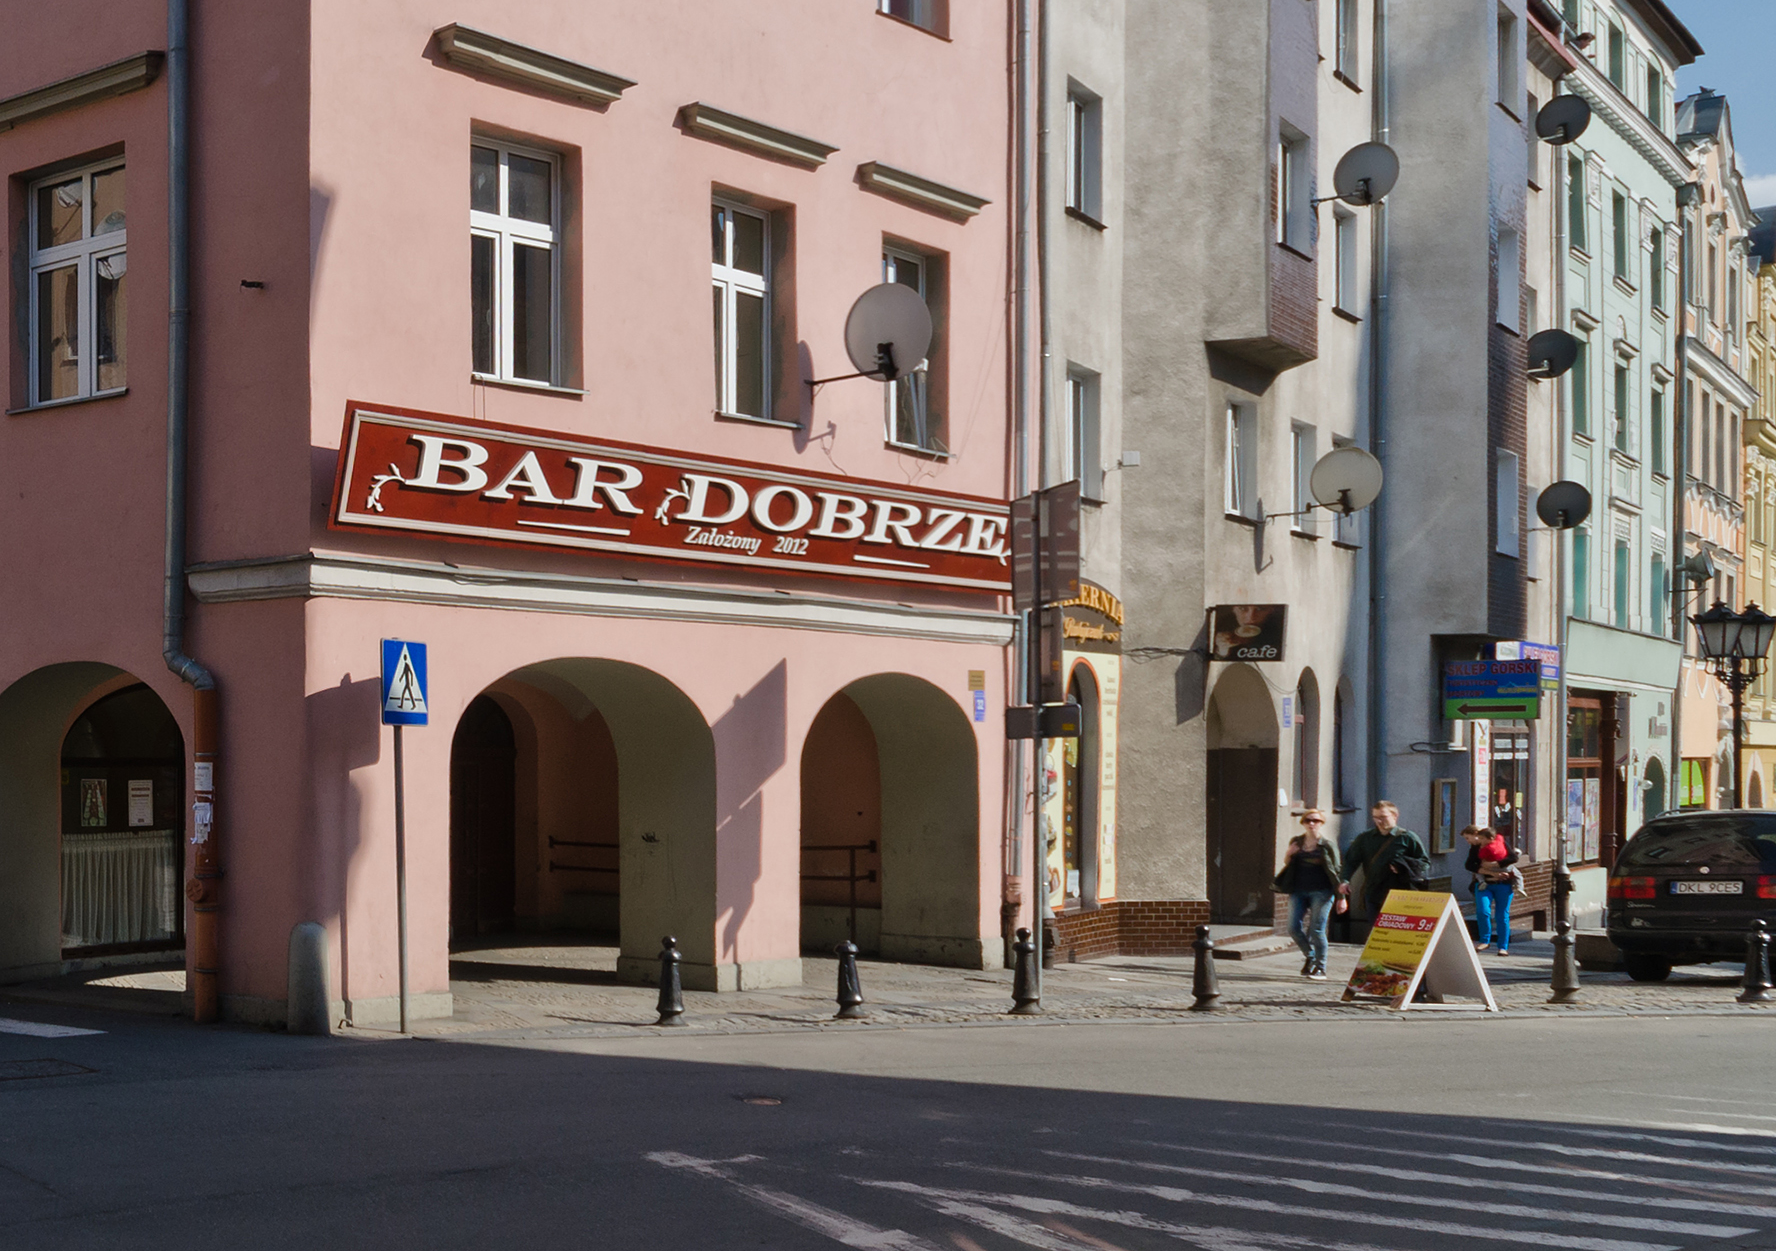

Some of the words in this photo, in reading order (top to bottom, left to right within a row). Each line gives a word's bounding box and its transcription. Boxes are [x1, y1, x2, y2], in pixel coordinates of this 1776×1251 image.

[404, 433, 645, 516] BAR
[675, 472, 1010, 557] DOBRZE
[683, 525, 762, 556] Założony
[772, 535, 810, 556] 2012
[1236, 644, 1278, 659] cafe
[1448, 663, 1487, 677] SKLEP
[1678, 883, 1705, 892] DKL
[1708, 883, 1741, 893] 9CES
[1378, 921, 1415, 930] OBIADOWY
[1418, 919, 1427, 930] 9
[1381, 914, 1407, 922] ZESTAW
